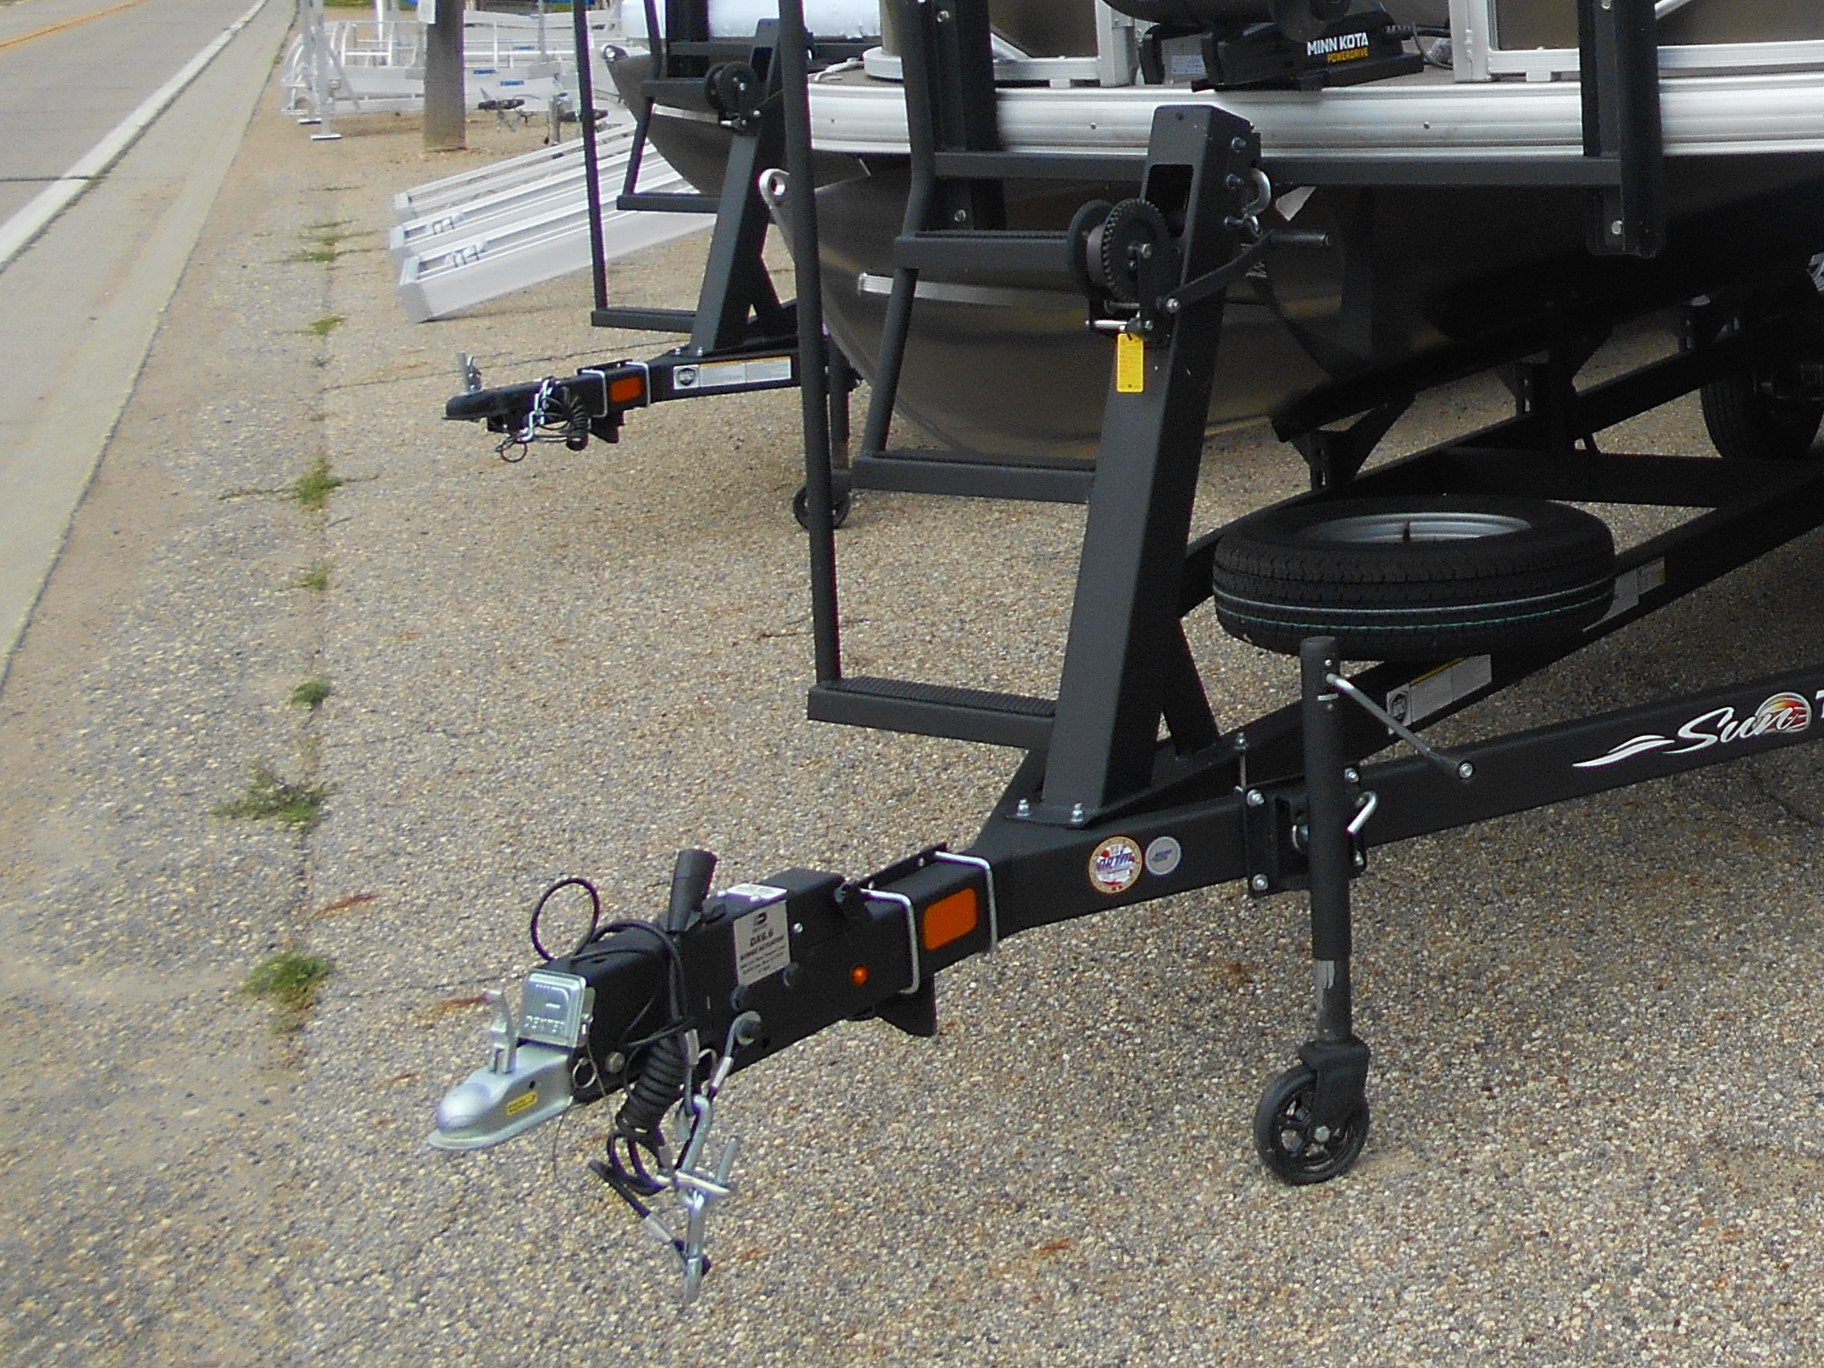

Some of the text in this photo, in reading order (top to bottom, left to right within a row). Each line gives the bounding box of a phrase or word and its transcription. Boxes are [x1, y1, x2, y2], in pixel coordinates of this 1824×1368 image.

[1306, 32, 1369, 56] MINN KOTA
[1327, 47, 1369, 63] POWERDRIVE
[1663, 706, 1800, 754] Sun
